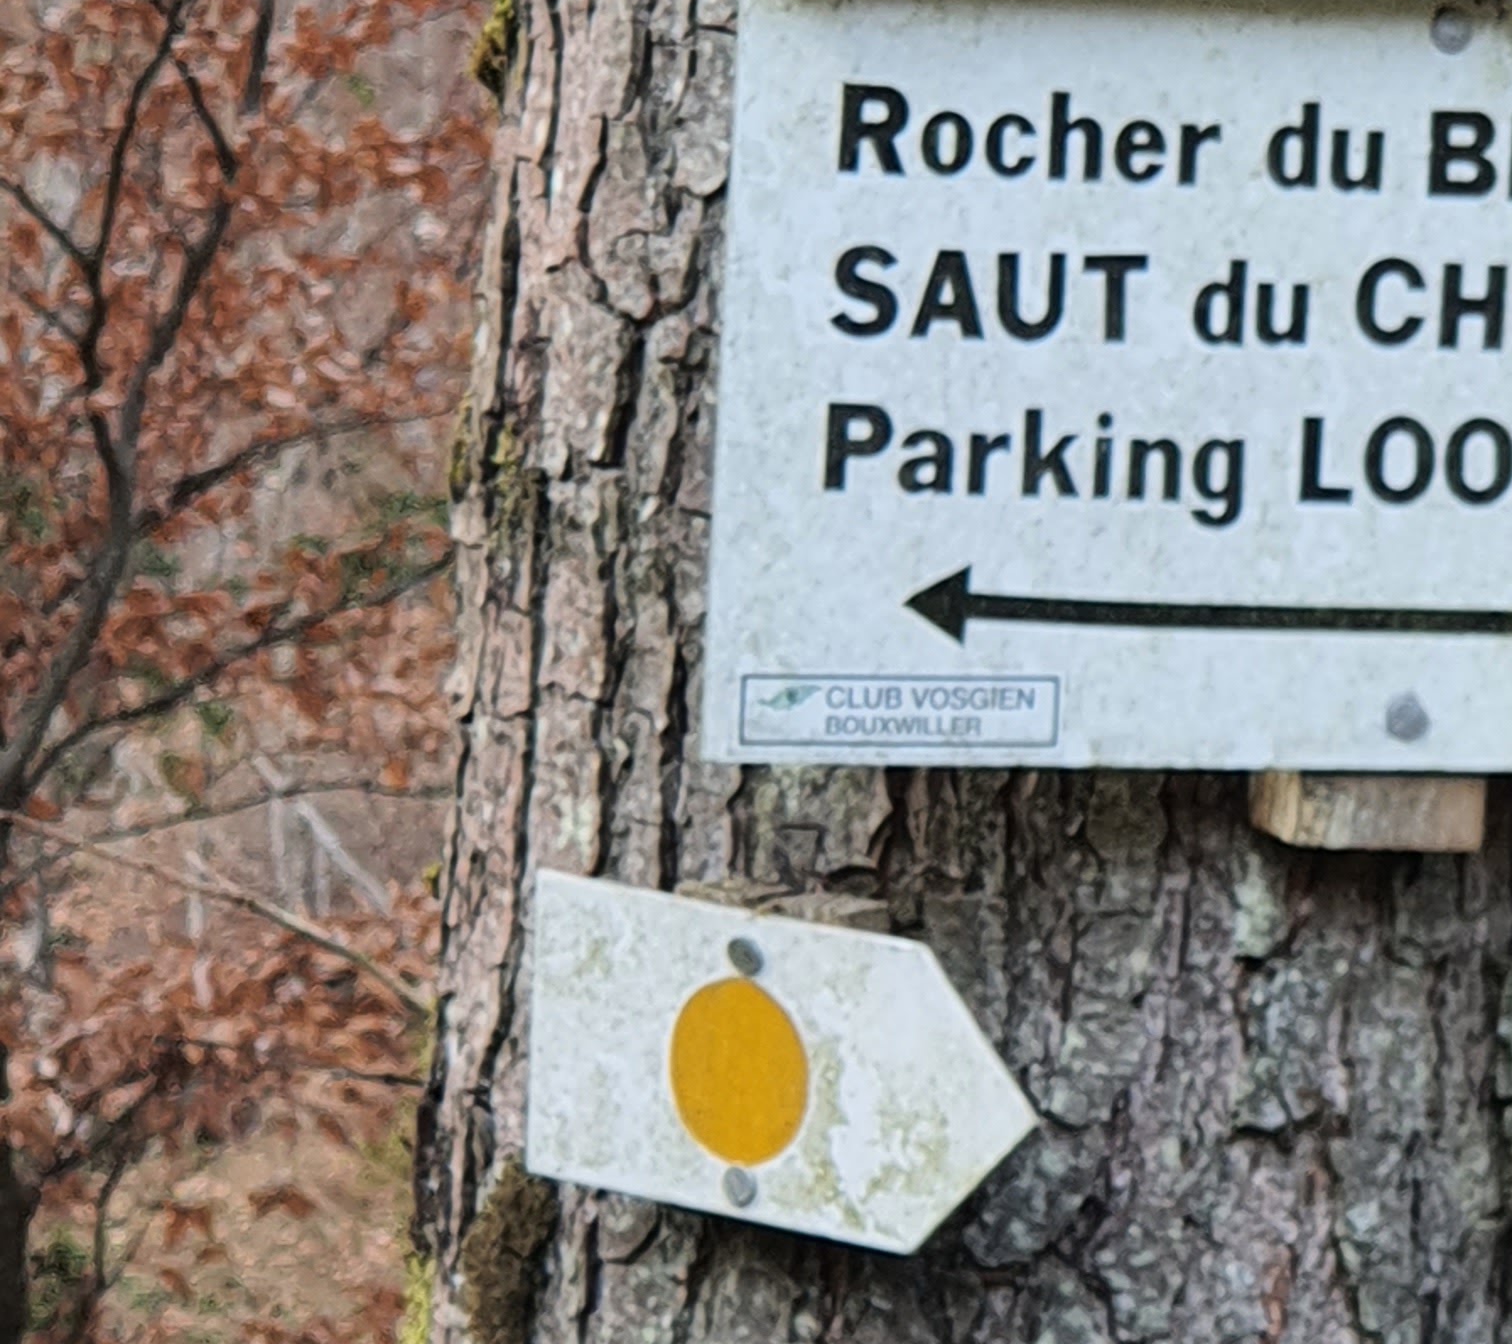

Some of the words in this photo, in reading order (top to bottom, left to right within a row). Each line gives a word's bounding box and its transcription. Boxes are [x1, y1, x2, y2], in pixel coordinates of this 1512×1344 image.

[838, 82, 1221, 185] Rocher
[1267, 102, 1385, 192] du
[830, 245, 1149, 342] SAUT
[1193, 259, 1310, 345] du
[824, 402, 1245, 528] Parking
[824, 685, 903, 710] CLUB
[911, 687, 1036, 711] VOSGIEN
[824, 715, 982, 737] BOUXWILLER
